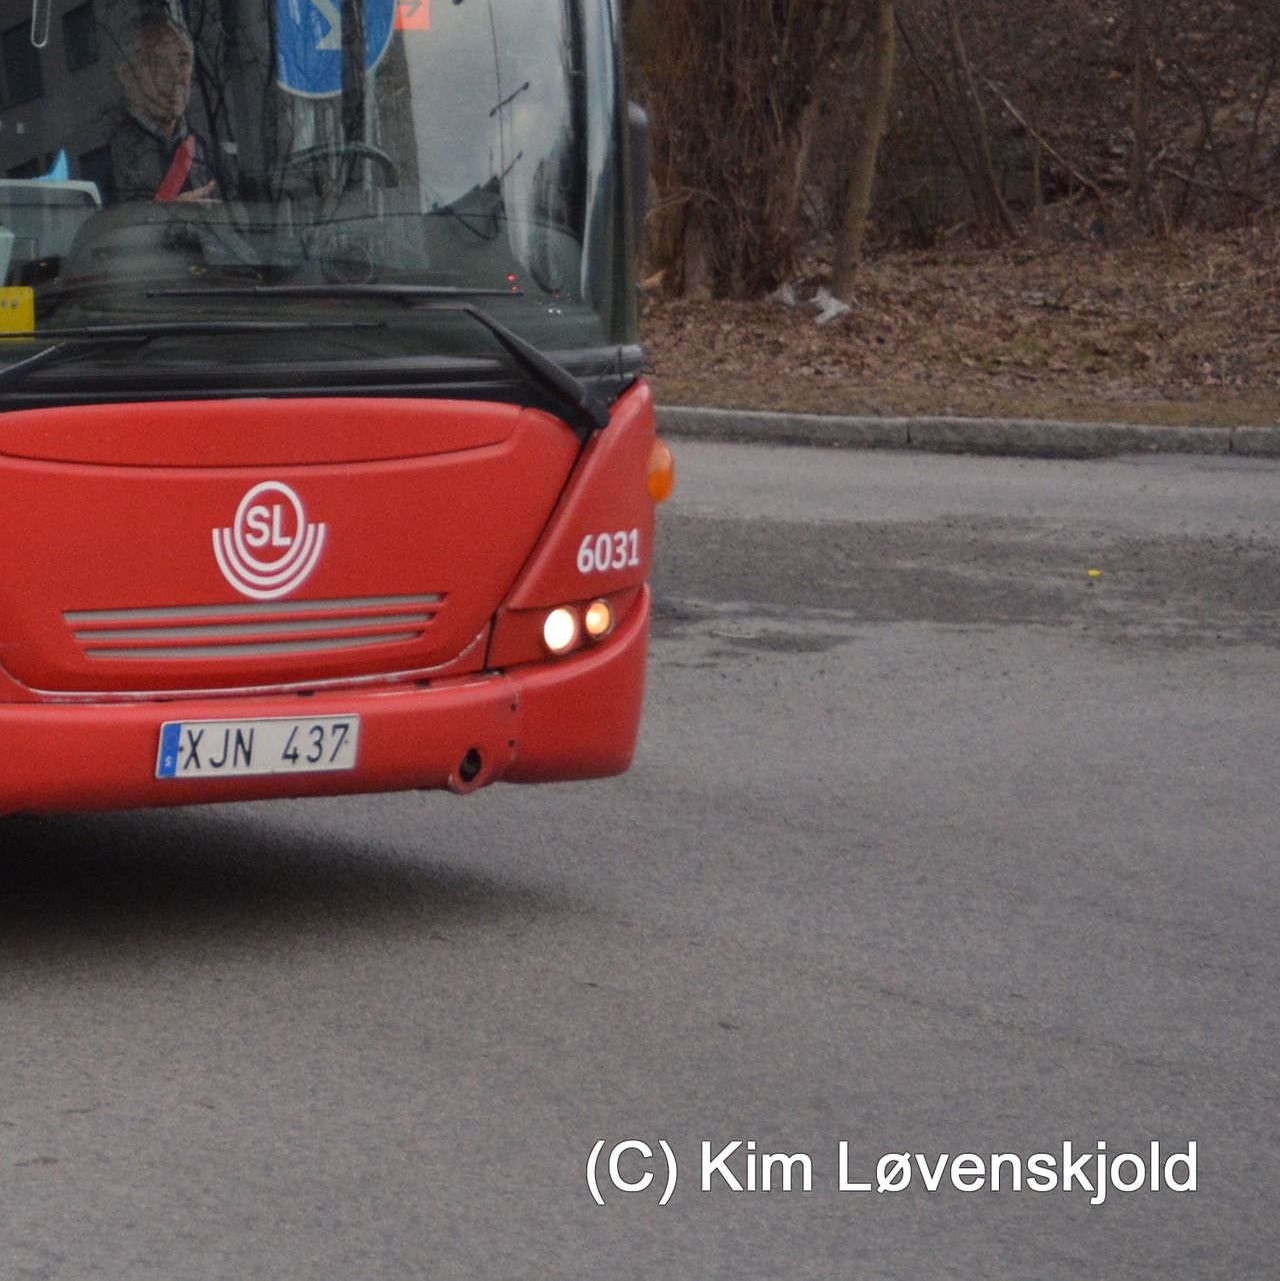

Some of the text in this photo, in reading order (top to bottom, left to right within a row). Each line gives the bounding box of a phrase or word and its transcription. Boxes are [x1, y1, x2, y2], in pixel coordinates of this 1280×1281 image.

[245, 504, 291, 547] SL
[576, 527, 639, 573] 6031
[183, 723, 350, 770] XJN 437
